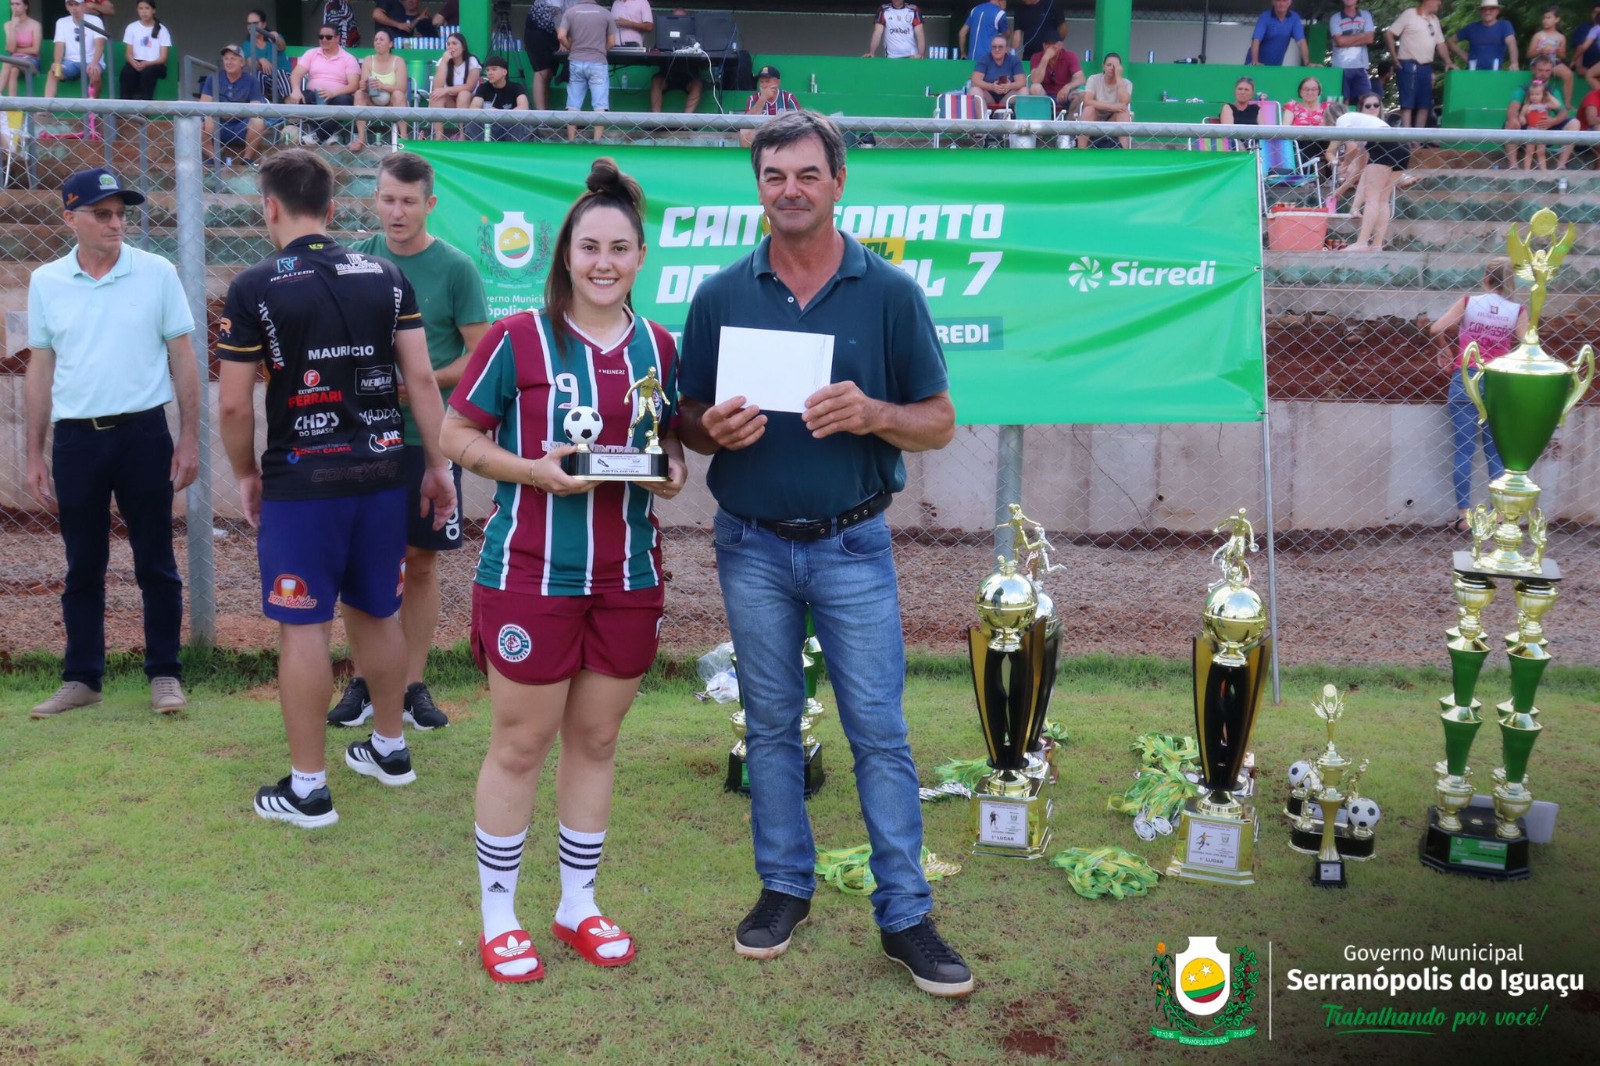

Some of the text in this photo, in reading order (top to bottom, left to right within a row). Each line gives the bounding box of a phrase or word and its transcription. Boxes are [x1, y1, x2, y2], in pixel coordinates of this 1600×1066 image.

[961, 251, 1004, 296] 7
[1109, 260, 1216, 286] Sicredi
[935, 324, 989, 344] REDI
[288, 390, 343, 409] FERRARI
[555, 372, 579, 409] 9
